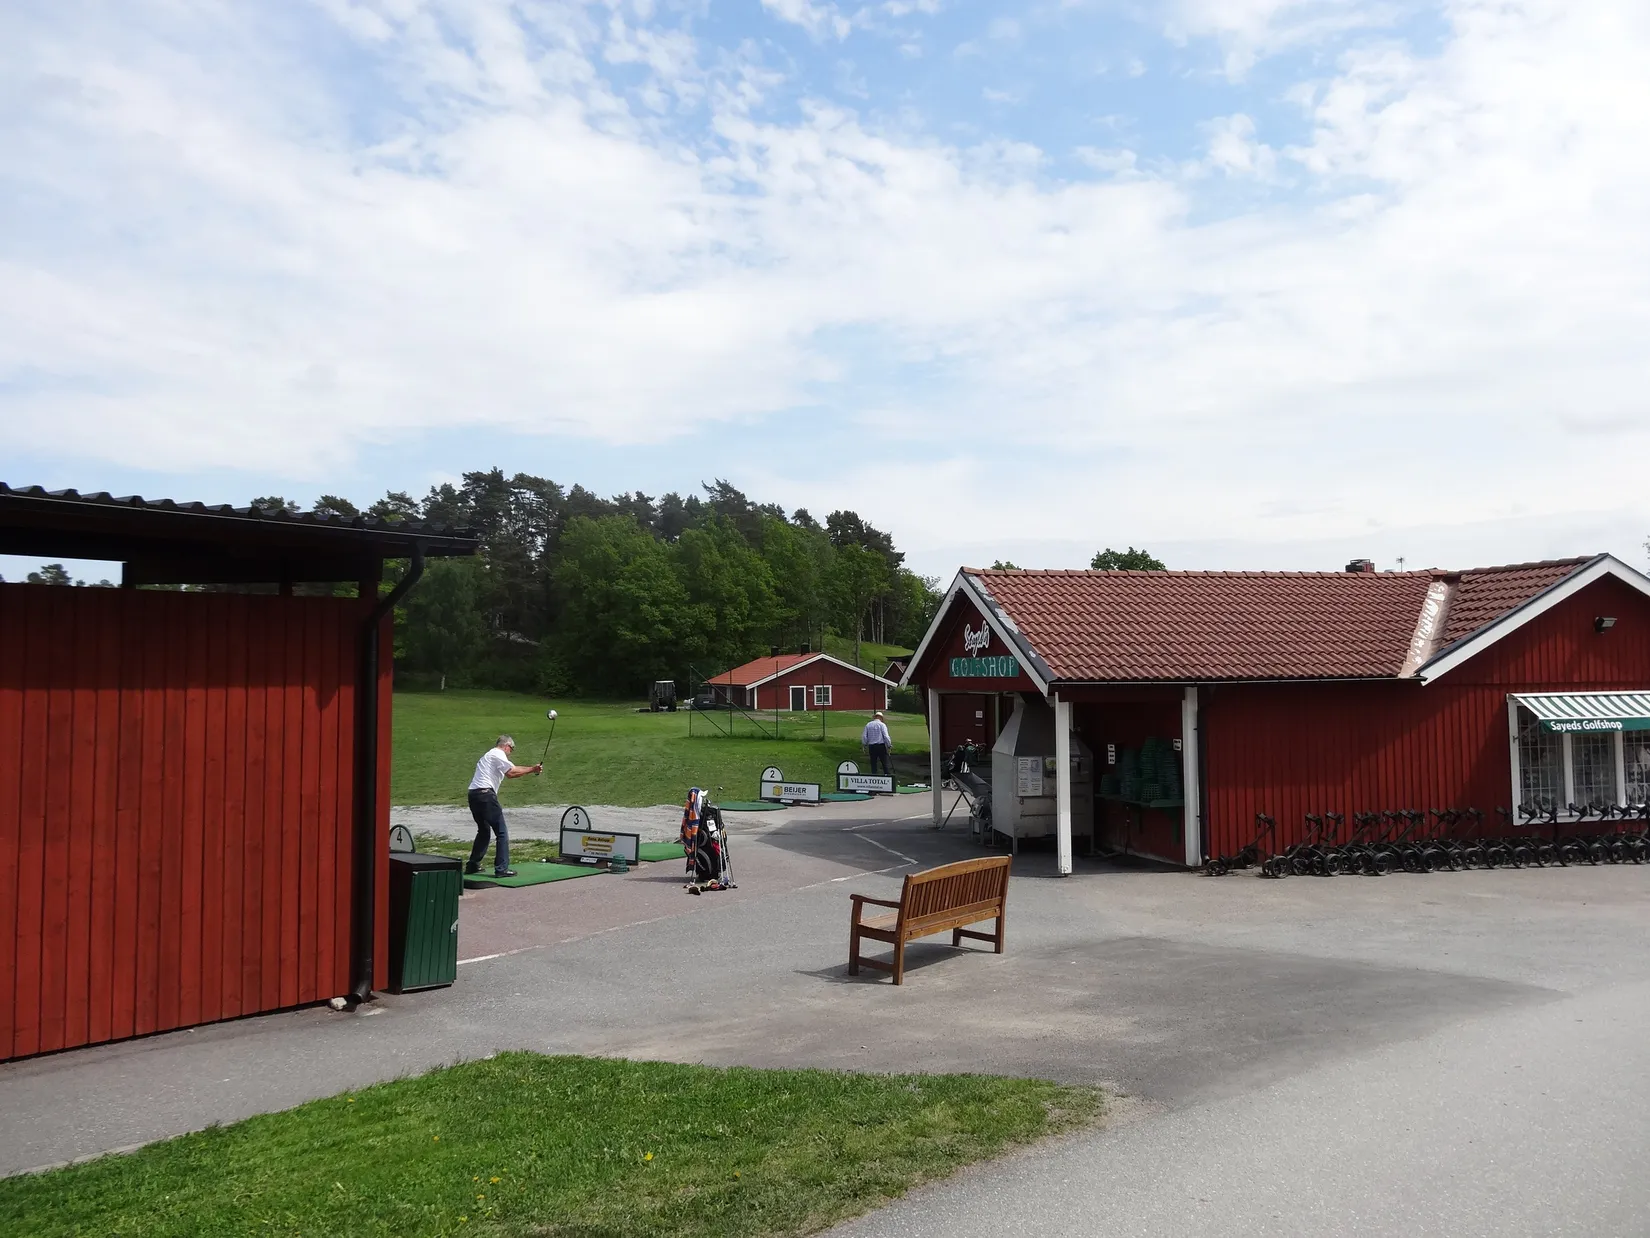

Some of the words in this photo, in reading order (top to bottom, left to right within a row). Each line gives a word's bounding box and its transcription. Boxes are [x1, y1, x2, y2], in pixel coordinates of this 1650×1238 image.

[1550, 720, 1582, 731] Sayeds
[1583, 719, 1622, 730] Golfshop
[770, 770, 775, 779] 2
[784, 786, 807, 794] BEIJER
[573, 813, 580, 825] 3
[396, 830, 403, 843] 4
